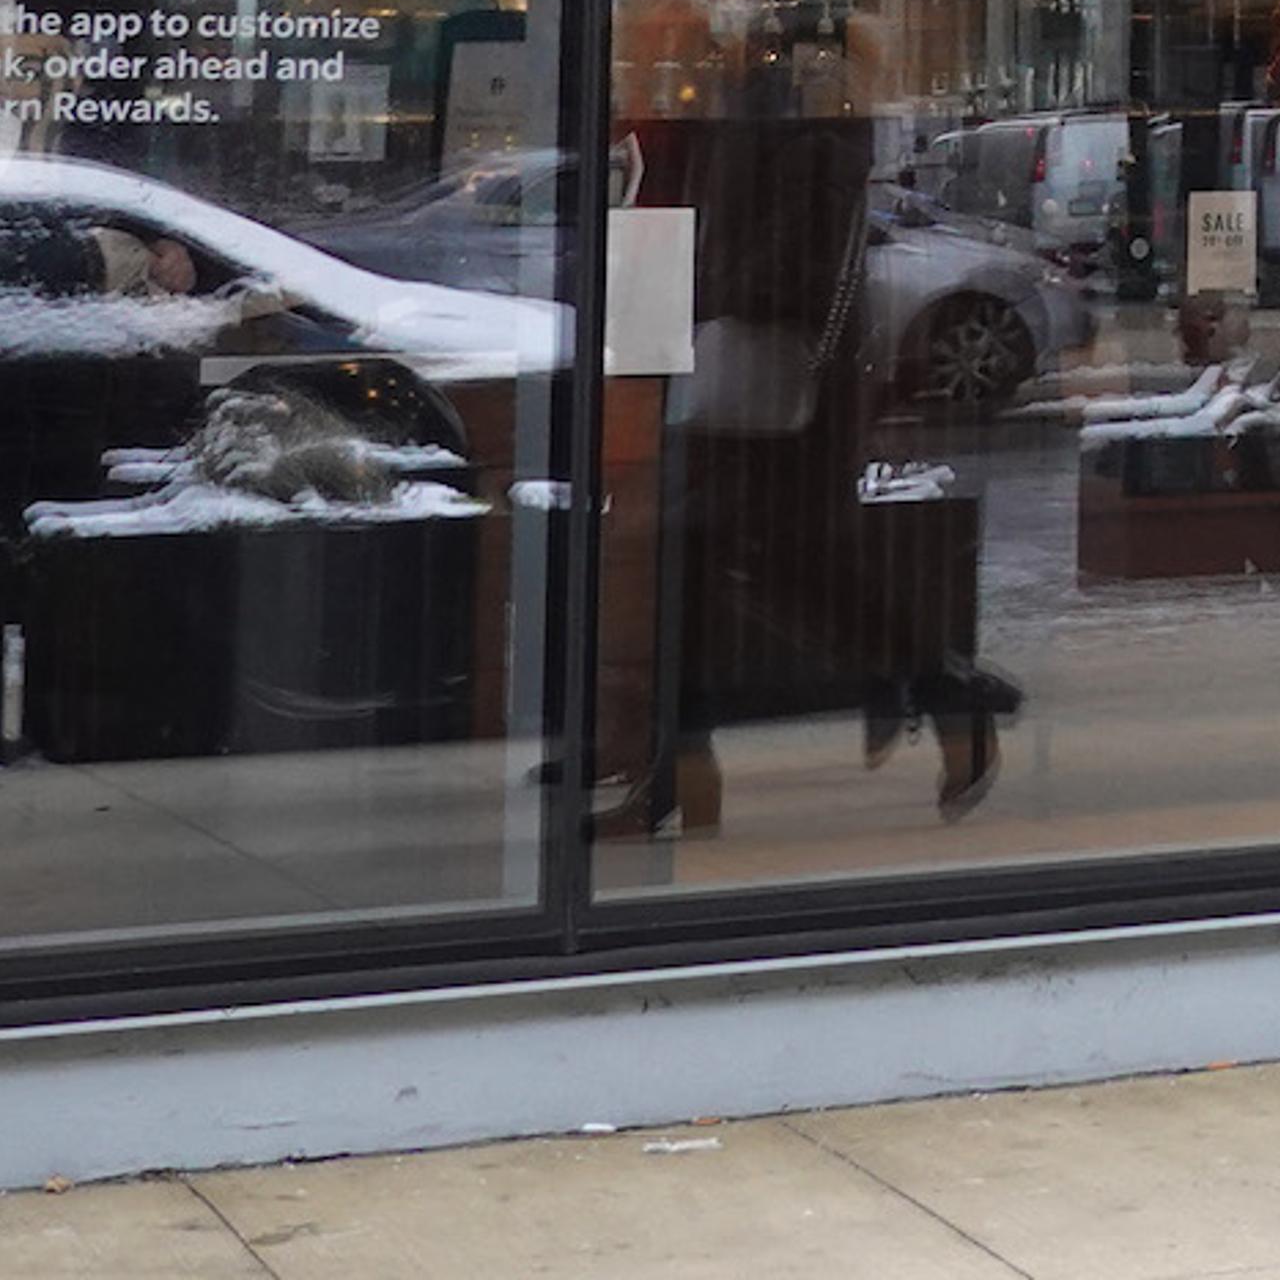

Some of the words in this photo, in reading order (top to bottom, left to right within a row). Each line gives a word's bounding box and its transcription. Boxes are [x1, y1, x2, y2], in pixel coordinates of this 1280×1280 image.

[70, 11, 141, 42] app
[151, 9, 189, 37] to
[198, 8, 381, 39] customize
[44, 49, 147, 80] order
[155, 48, 268, 81] ahead
[276, 51, 344, 81] and
[53, 91, 221, 123] Rewards.
[1201, 212, 1245, 233] SALE
